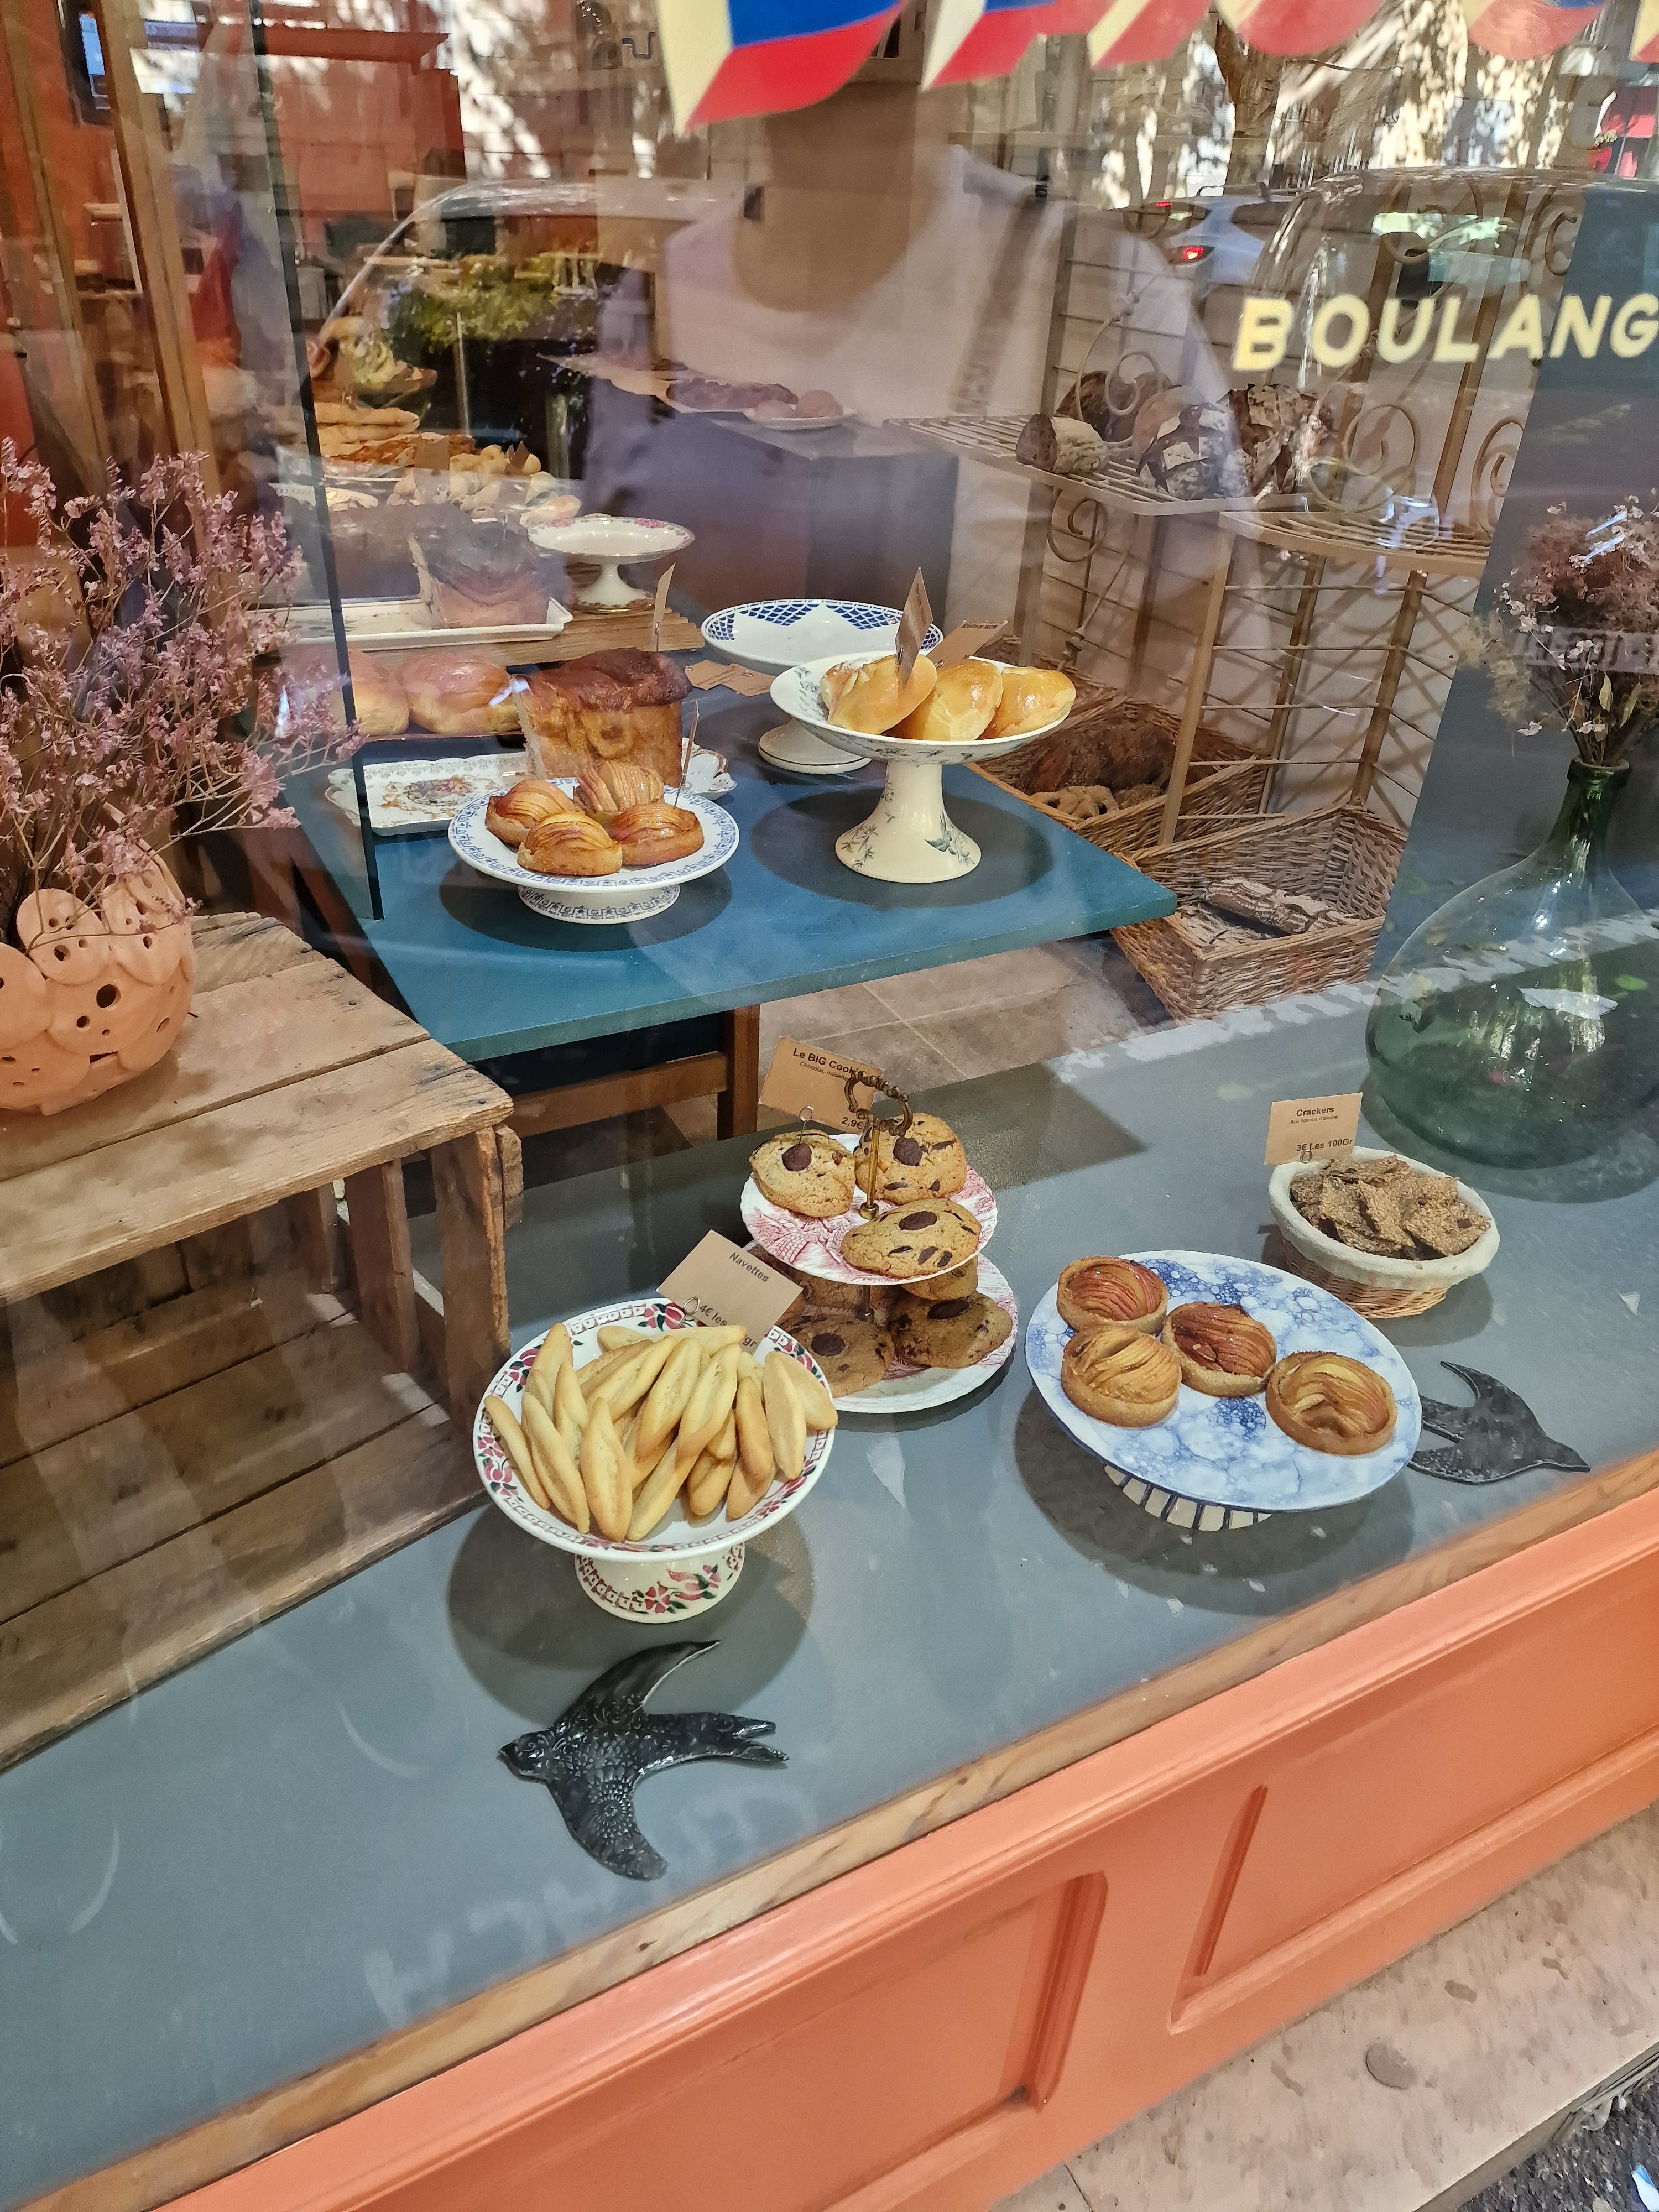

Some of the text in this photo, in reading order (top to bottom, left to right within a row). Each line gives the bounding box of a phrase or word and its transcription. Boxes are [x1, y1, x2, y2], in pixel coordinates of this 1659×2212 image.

[1233, 293, 1659, 371] BOULANG
[793, 1048, 805, 1058] Le
[807, 1052, 827, 1065] BIG
[1296, 1107, 1334, 1117] Crackers
[1328, 1138, 1354, 1147] 100Gr
[729, 1251, 769, 1282] Navettes
[699, 1305, 714, 1317] 4€
